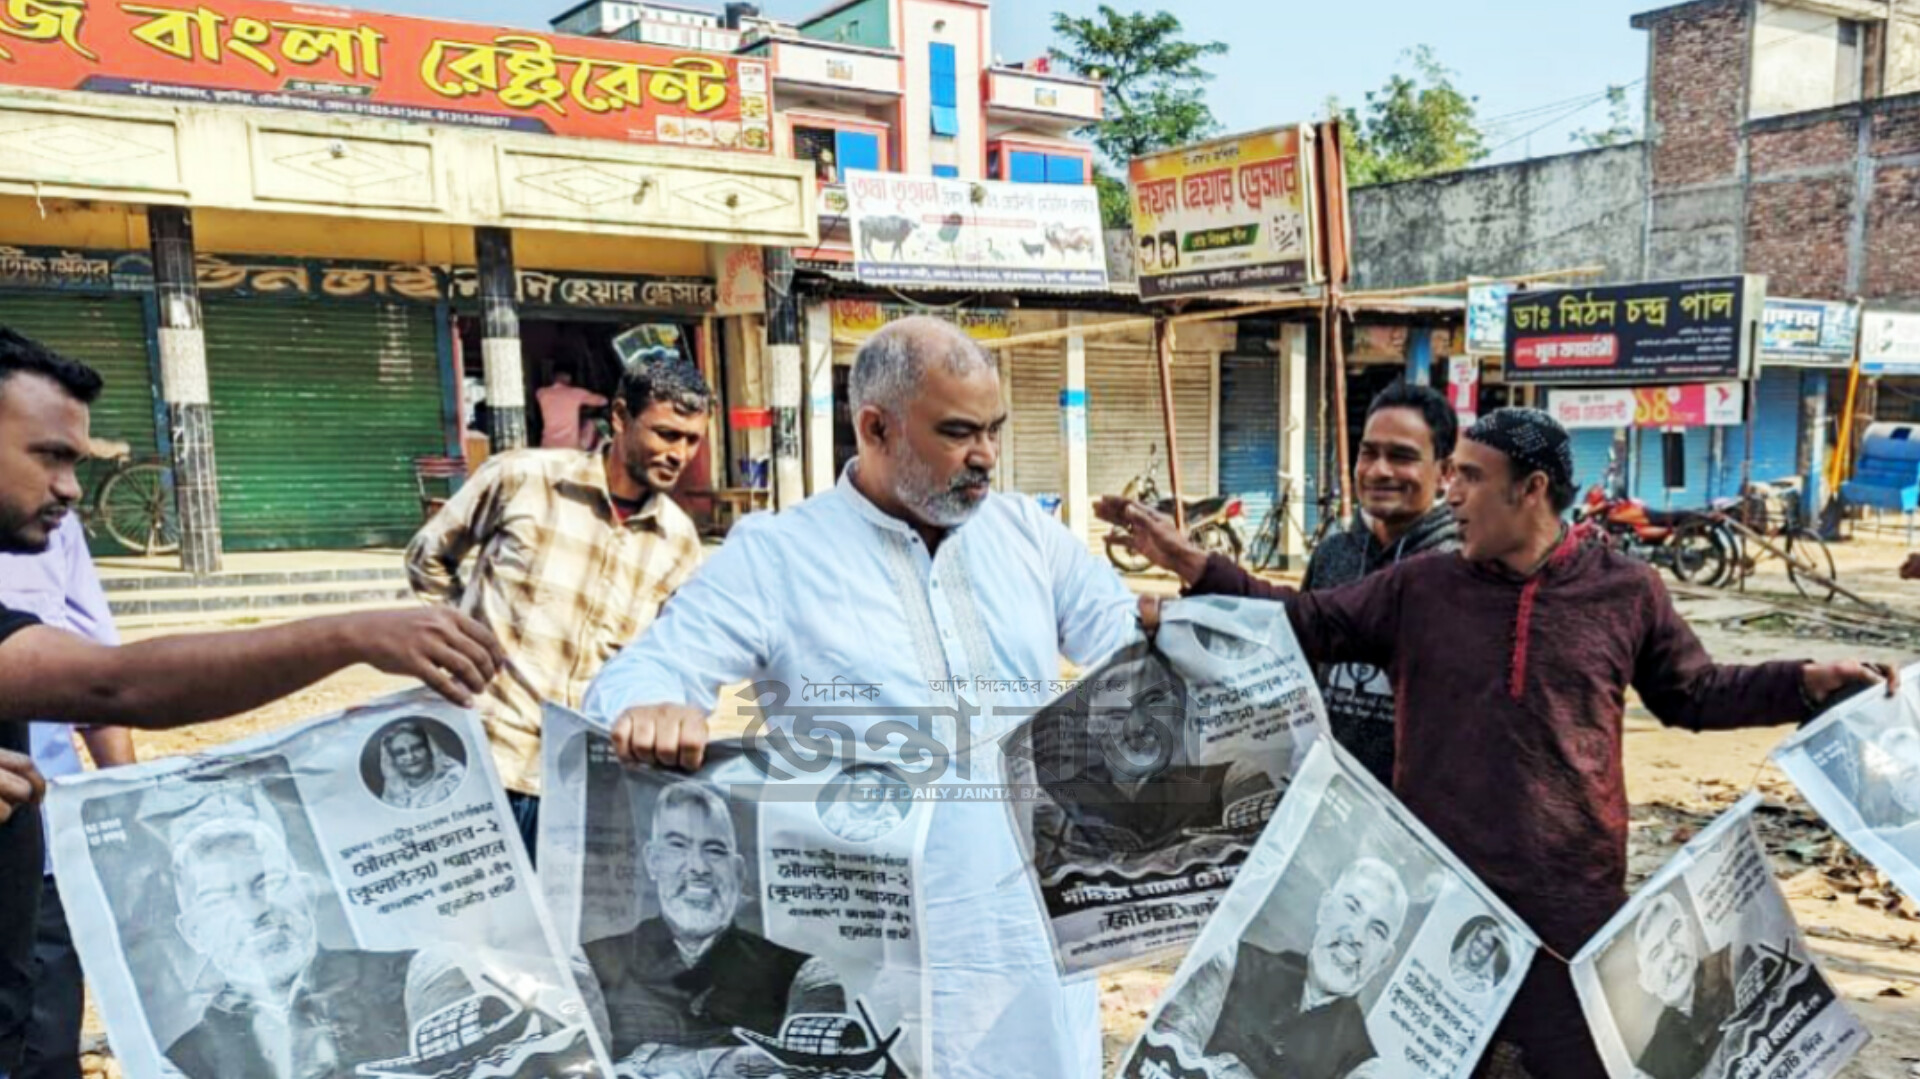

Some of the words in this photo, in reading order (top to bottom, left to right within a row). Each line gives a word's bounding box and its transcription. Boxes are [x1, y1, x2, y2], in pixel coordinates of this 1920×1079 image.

[121, 7, 385, 78] বাংলা
[321, 263, 440, 298] ভাই
[1512, 304, 1551, 330] ডাঃ
[1679, 291, 1735, 322] পাল
